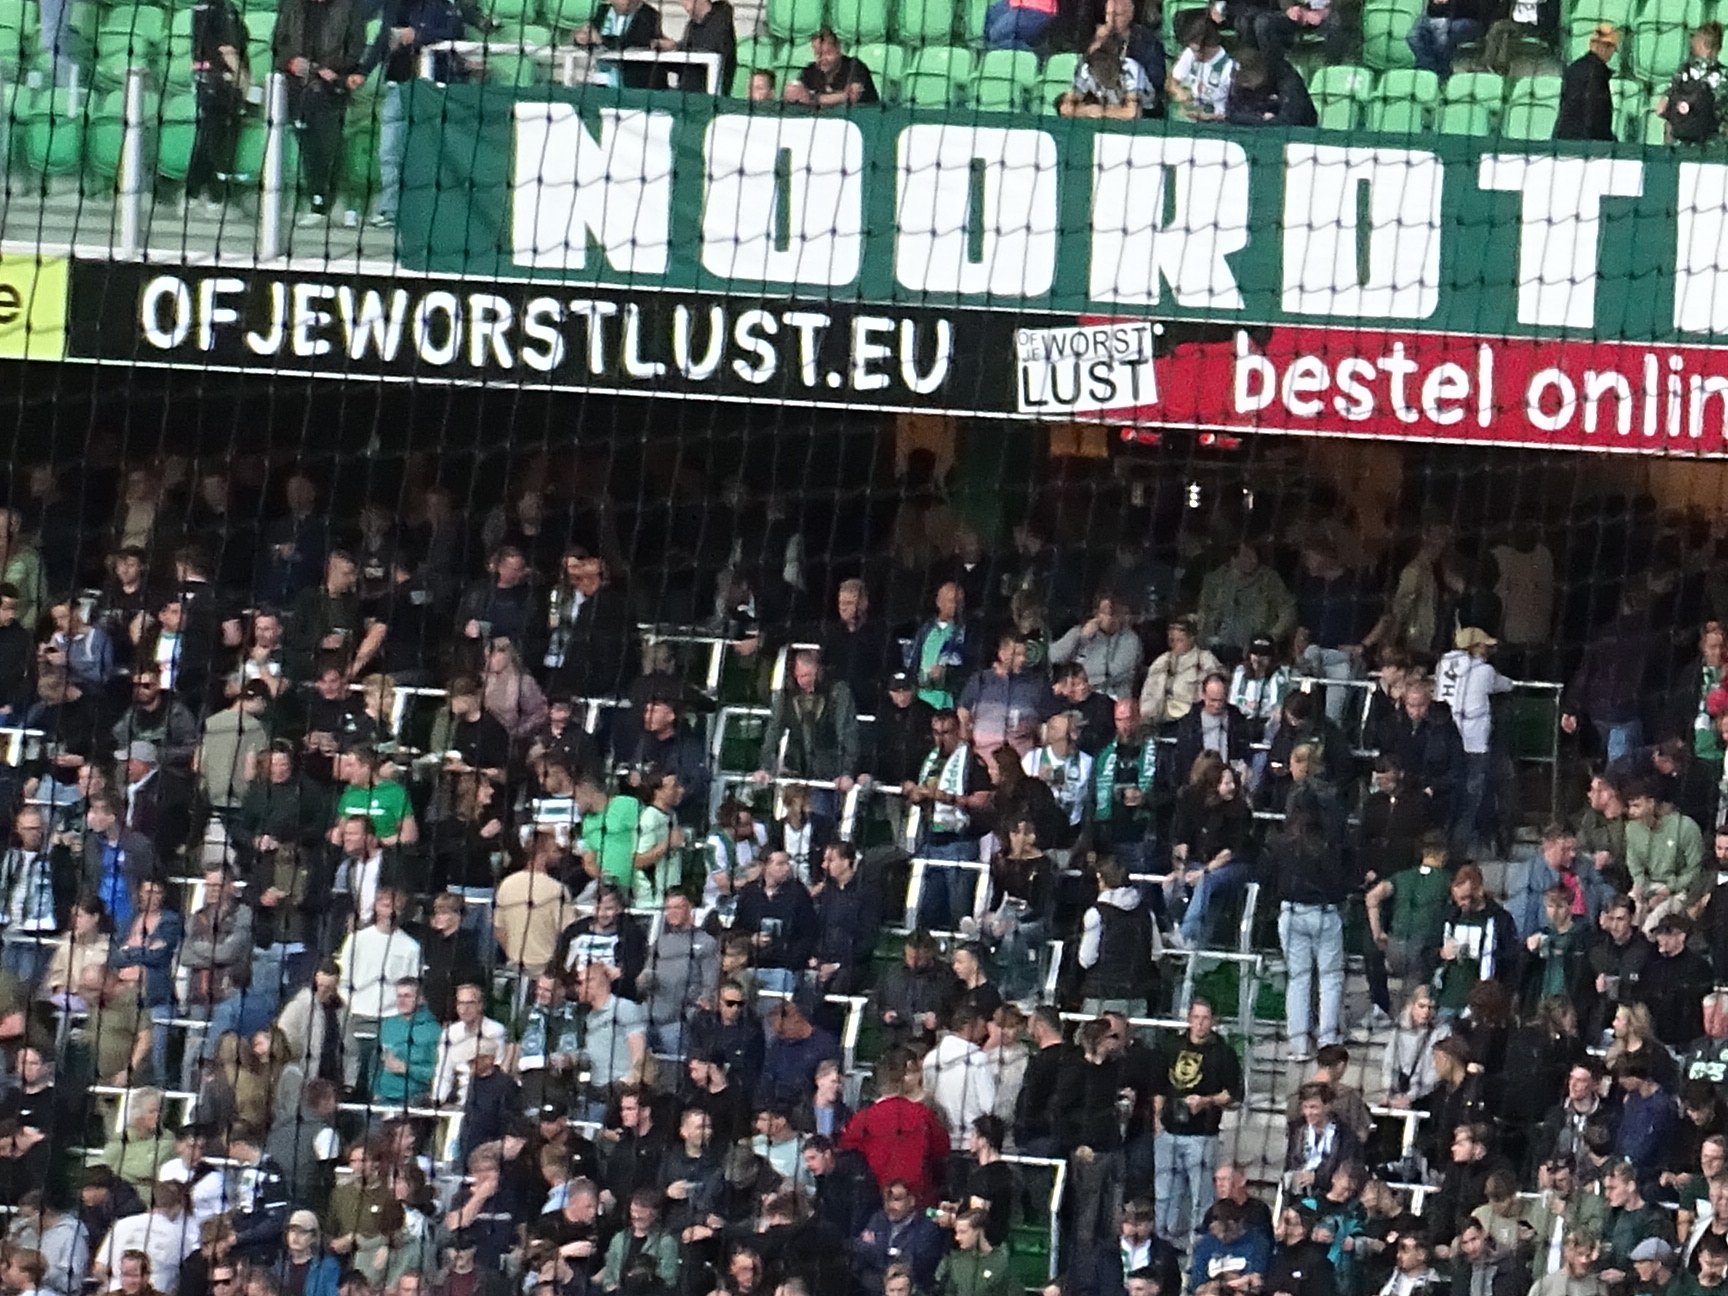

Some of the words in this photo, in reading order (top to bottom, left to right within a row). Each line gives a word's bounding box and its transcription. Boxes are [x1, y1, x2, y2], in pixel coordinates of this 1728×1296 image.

[1042, 326, 1148, 358] WORST
[1022, 358, 1150, 406] LUST
[1233, 330, 1494, 429] bestel
